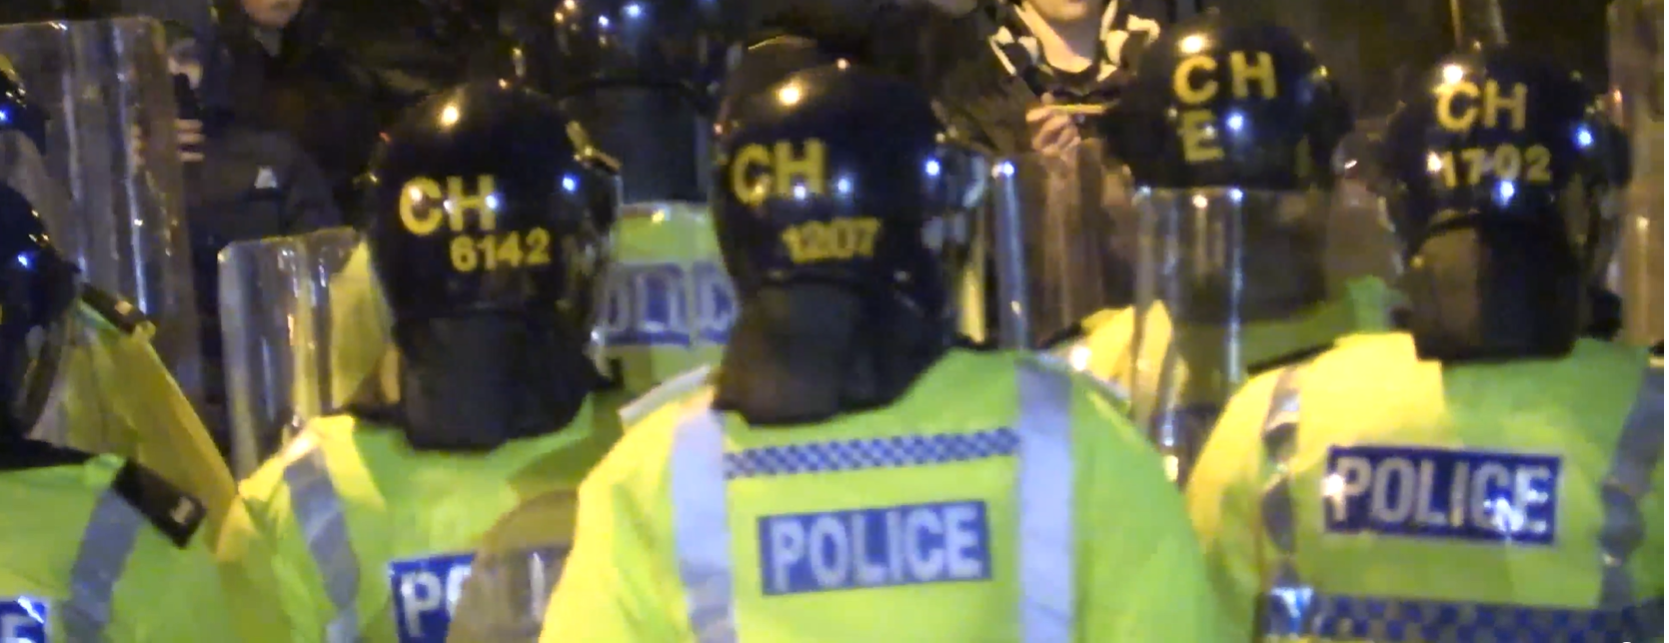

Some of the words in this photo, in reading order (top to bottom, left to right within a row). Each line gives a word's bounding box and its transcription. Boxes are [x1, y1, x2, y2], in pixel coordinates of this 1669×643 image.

[1173, 51, 1277, 104] CH
[1436, 80, 1527, 131] CH
[1182, 109, 1224, 163] E
[732, 138, 824, 206] CH
[1439, 144, 1552, 188] 1702
[400, 174, 496, 236] CH
[451, 227, 550, 272] 6142
[1332, 457, 1551, 534] POLICE
[771, 504, 983, 592] POLICE
